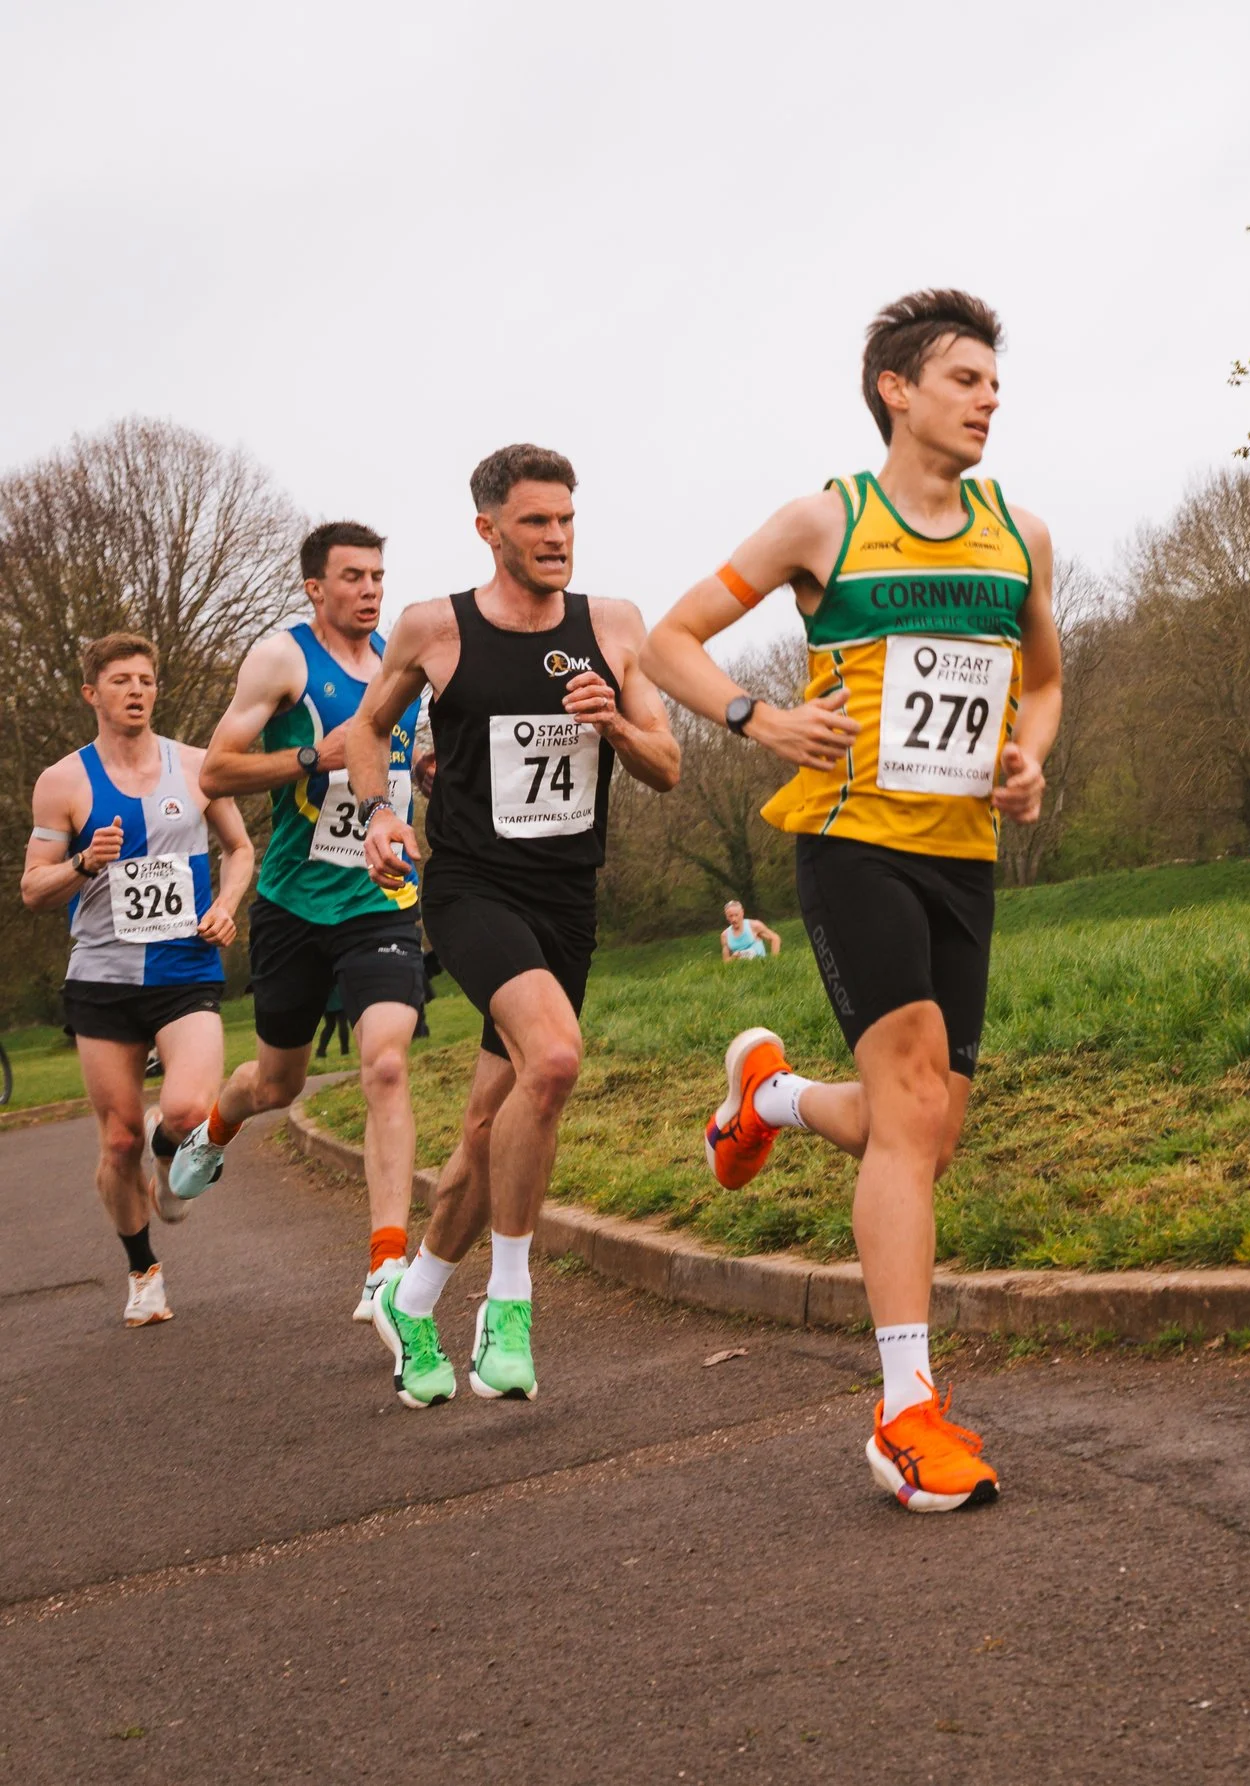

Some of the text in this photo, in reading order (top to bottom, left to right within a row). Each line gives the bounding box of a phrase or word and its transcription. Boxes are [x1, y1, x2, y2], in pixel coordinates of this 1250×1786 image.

[870, 581, 1013, 610] CORNWALL
[941, 654, 993, 672] START
[937, 670, 989, 685] FITNESS
[537, 723, 582, 737] START
[903, 691, 989, 754] 279
[535, 735, 580, 747] FITNESS
[524, 755, 574, 804] 74
[883, 761, 991, 781] STARTFITNESS.CO.UK
[498, 808, 592, 824] STARTFITNESS.CO.UK
[141, 861, 174, 872] START
[124, 882, 183, 920] 326
